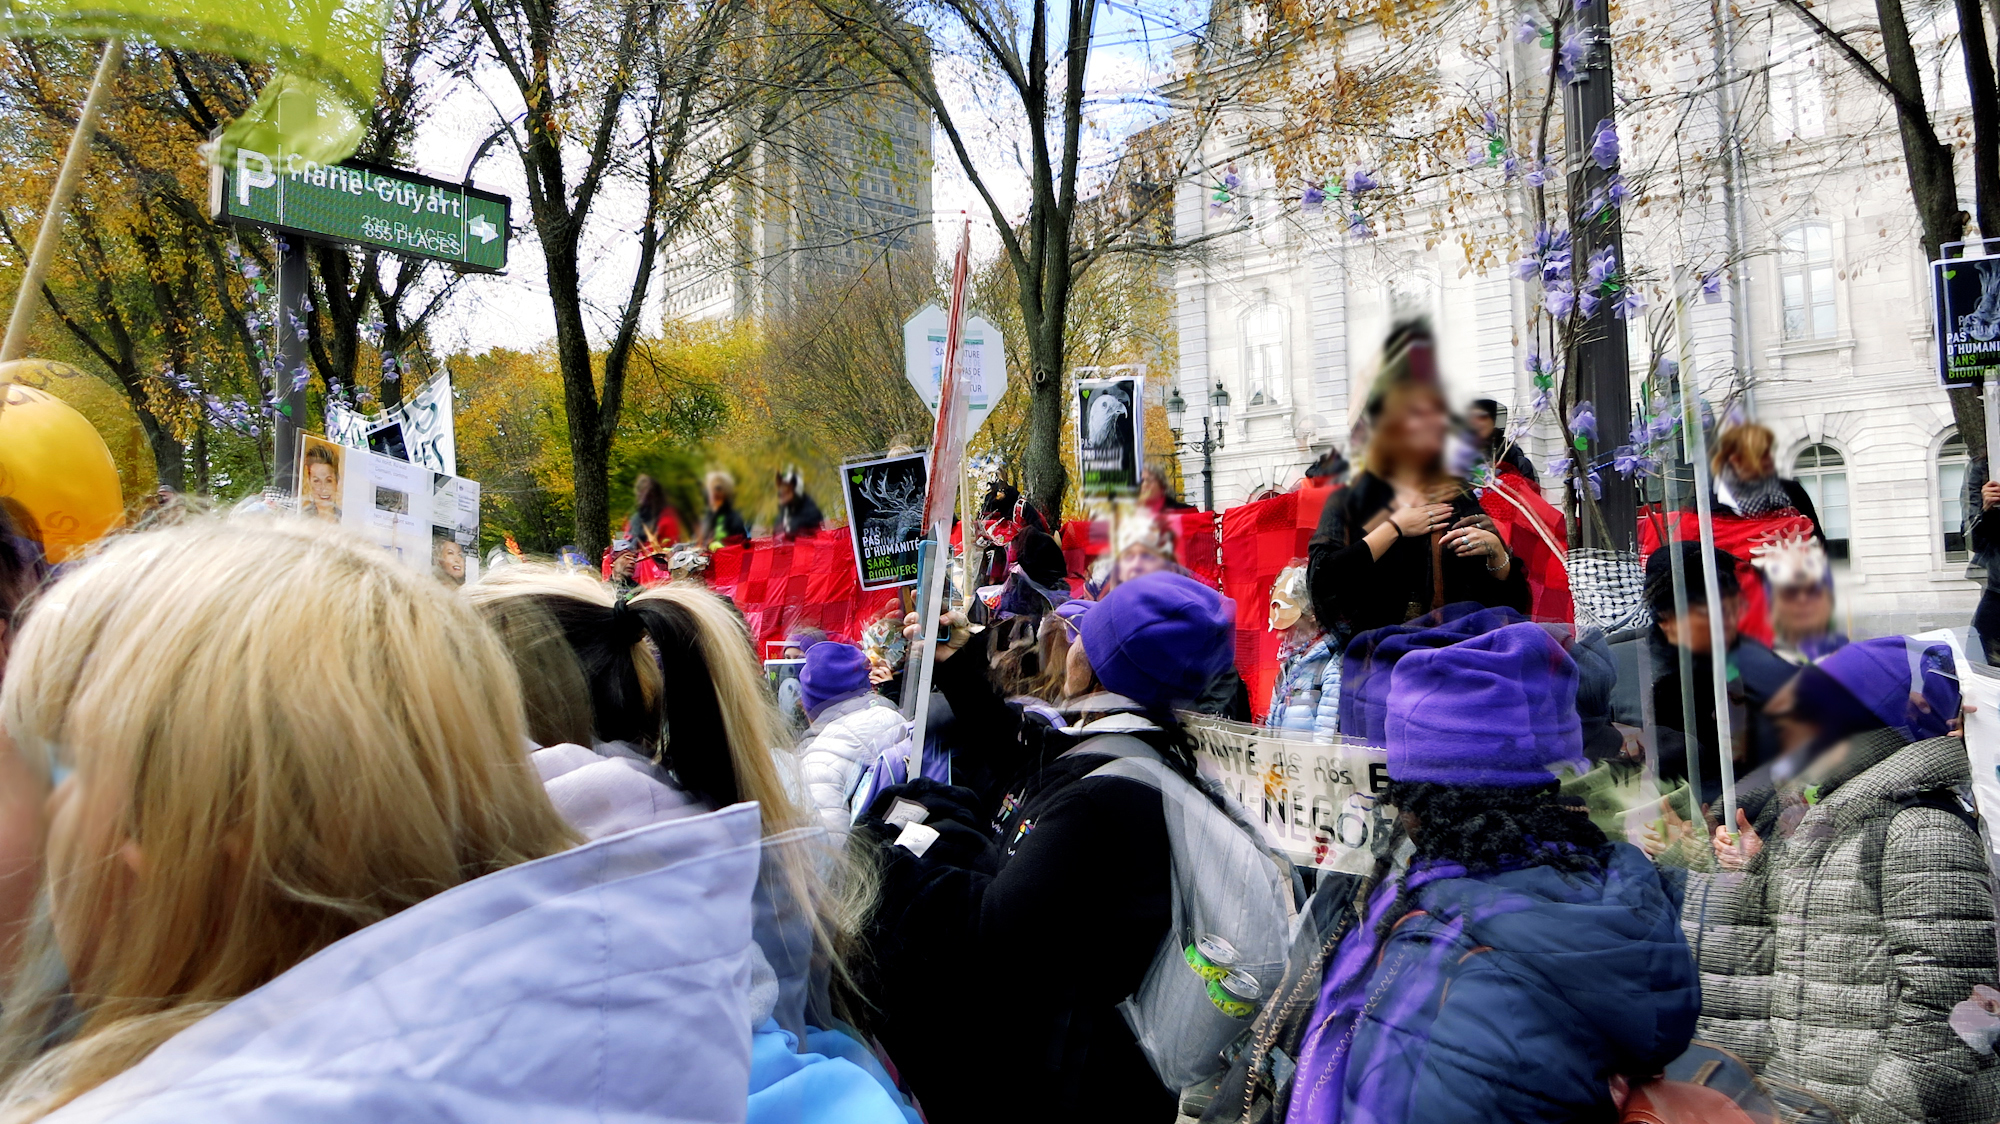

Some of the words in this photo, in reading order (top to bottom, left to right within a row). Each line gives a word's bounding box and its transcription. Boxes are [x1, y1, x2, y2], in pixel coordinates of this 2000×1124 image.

[236, 148, 277, 206] P
[1946, 332, 1968, 344] PAS
[963, 349, 981, 359] TURE
[1947, 354, 1977, 367] SANS
[862, 534, 880, 548] PAS
[864, 537, 919, 558] D'HUMANITÉ
[867, 556, 891, 569] SANS
